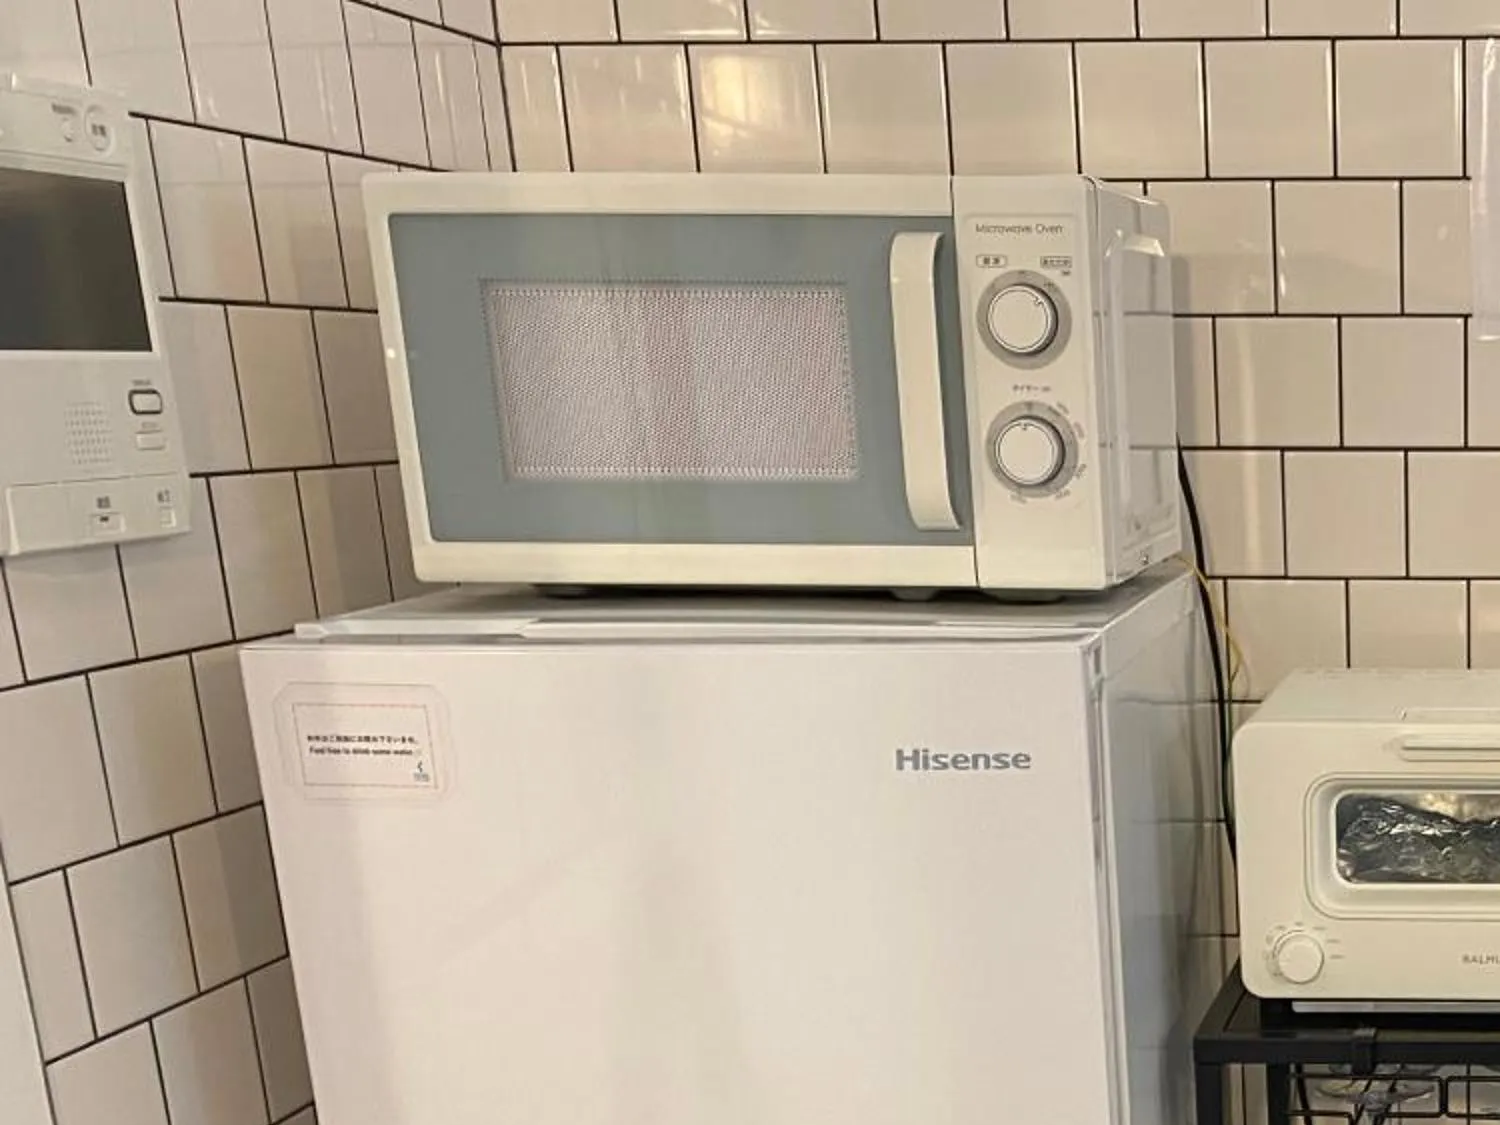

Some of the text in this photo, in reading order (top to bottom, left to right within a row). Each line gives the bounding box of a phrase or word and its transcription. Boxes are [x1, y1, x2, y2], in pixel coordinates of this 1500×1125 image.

[975, 223, 1064, 233] Microwave Oven
[895, 748, 1032, 771] Hisense
